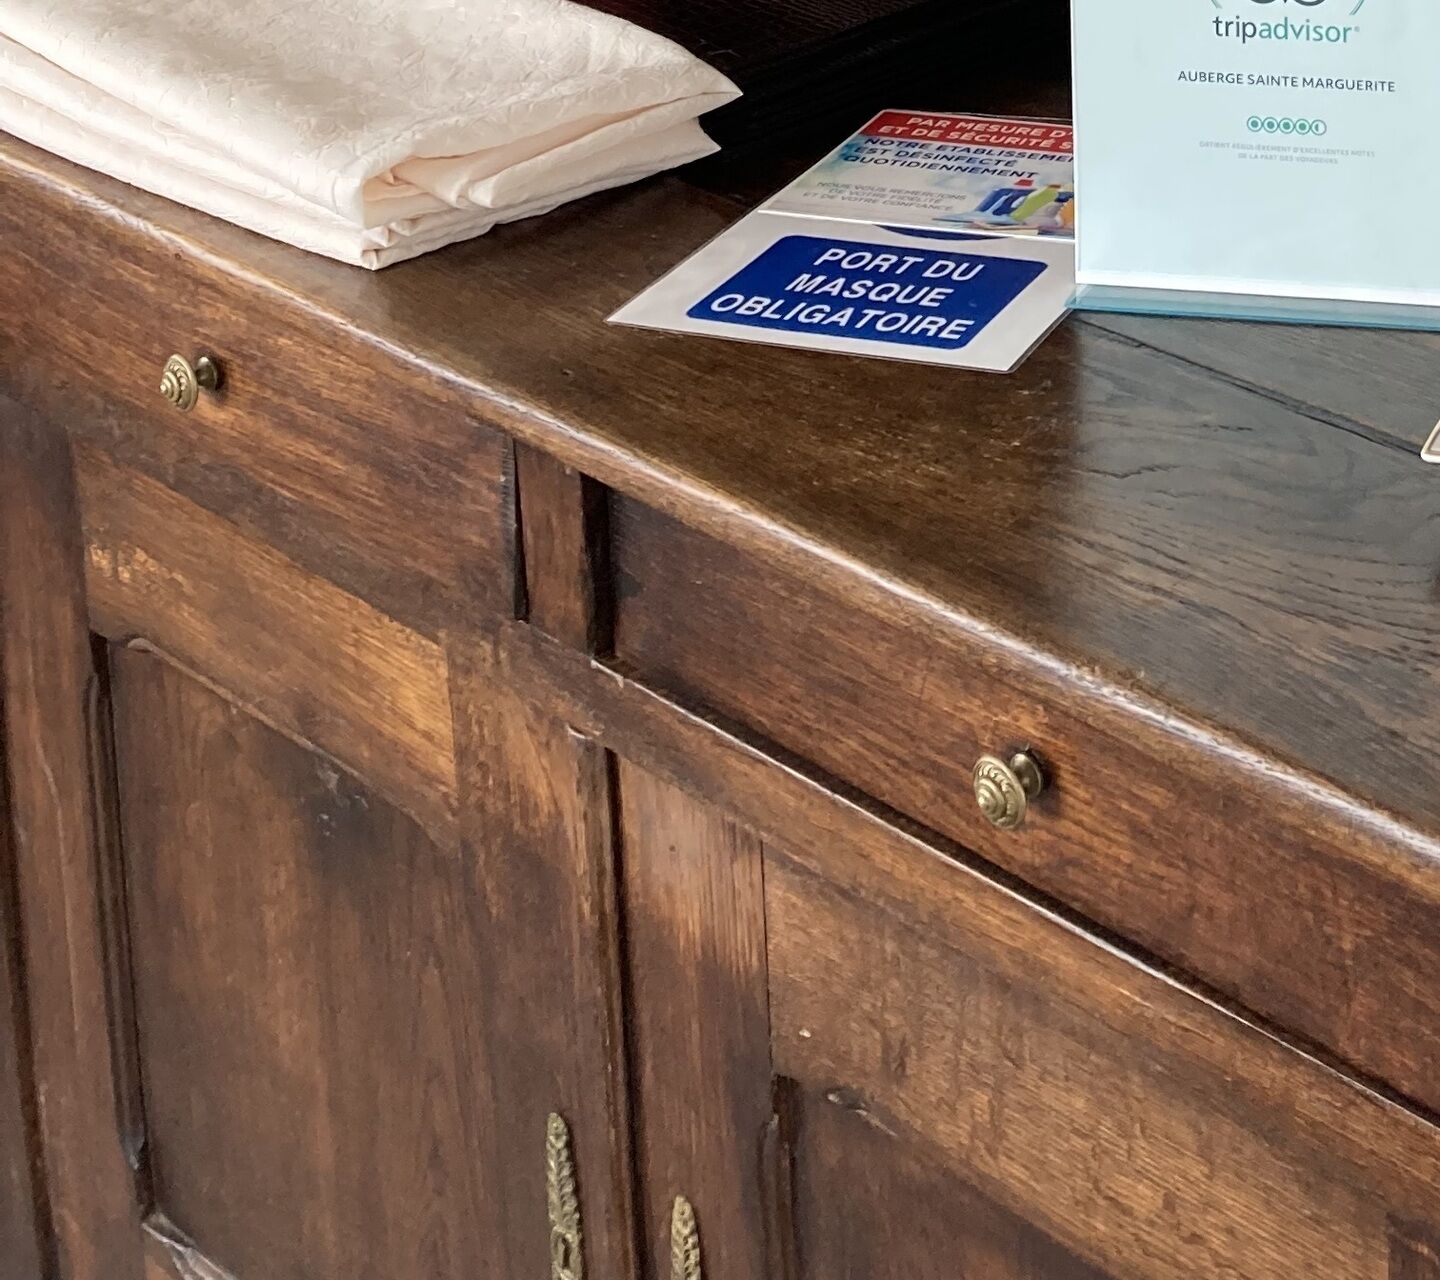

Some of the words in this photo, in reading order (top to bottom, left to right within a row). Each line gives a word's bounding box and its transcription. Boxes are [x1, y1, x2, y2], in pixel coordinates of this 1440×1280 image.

[1212, 14, 1353, 44] tripadvisor
[1178, 70, 1244, 85] AUBERGE
[1247, 74, 1299, 88] SAINTE
[1302, 76, 1396, 93] MARGUERITE
[878, 125, 910, 135] ET
[913, 127, 945, 138] DE
[952, 129, 1056, 150] SÉCURITÉ
[907, 117, 952, 129] PAR
[956, 120, 1043, 138] MESURE
[854, 146, 893, 156] EST
[897, 148, 1017, 168] DÉSINFECTÉ
[865, 138, 939, 151] NOTRE
[845, 154, 1040, 179] QUOTIDIENNEMENT
[813, 248, 923, 274] PORT
[921, 259, 984, 281] DU
[784, 273, 954, 308] MASQUE
[710, 293, 975, 341] OBLIGATOIRE
